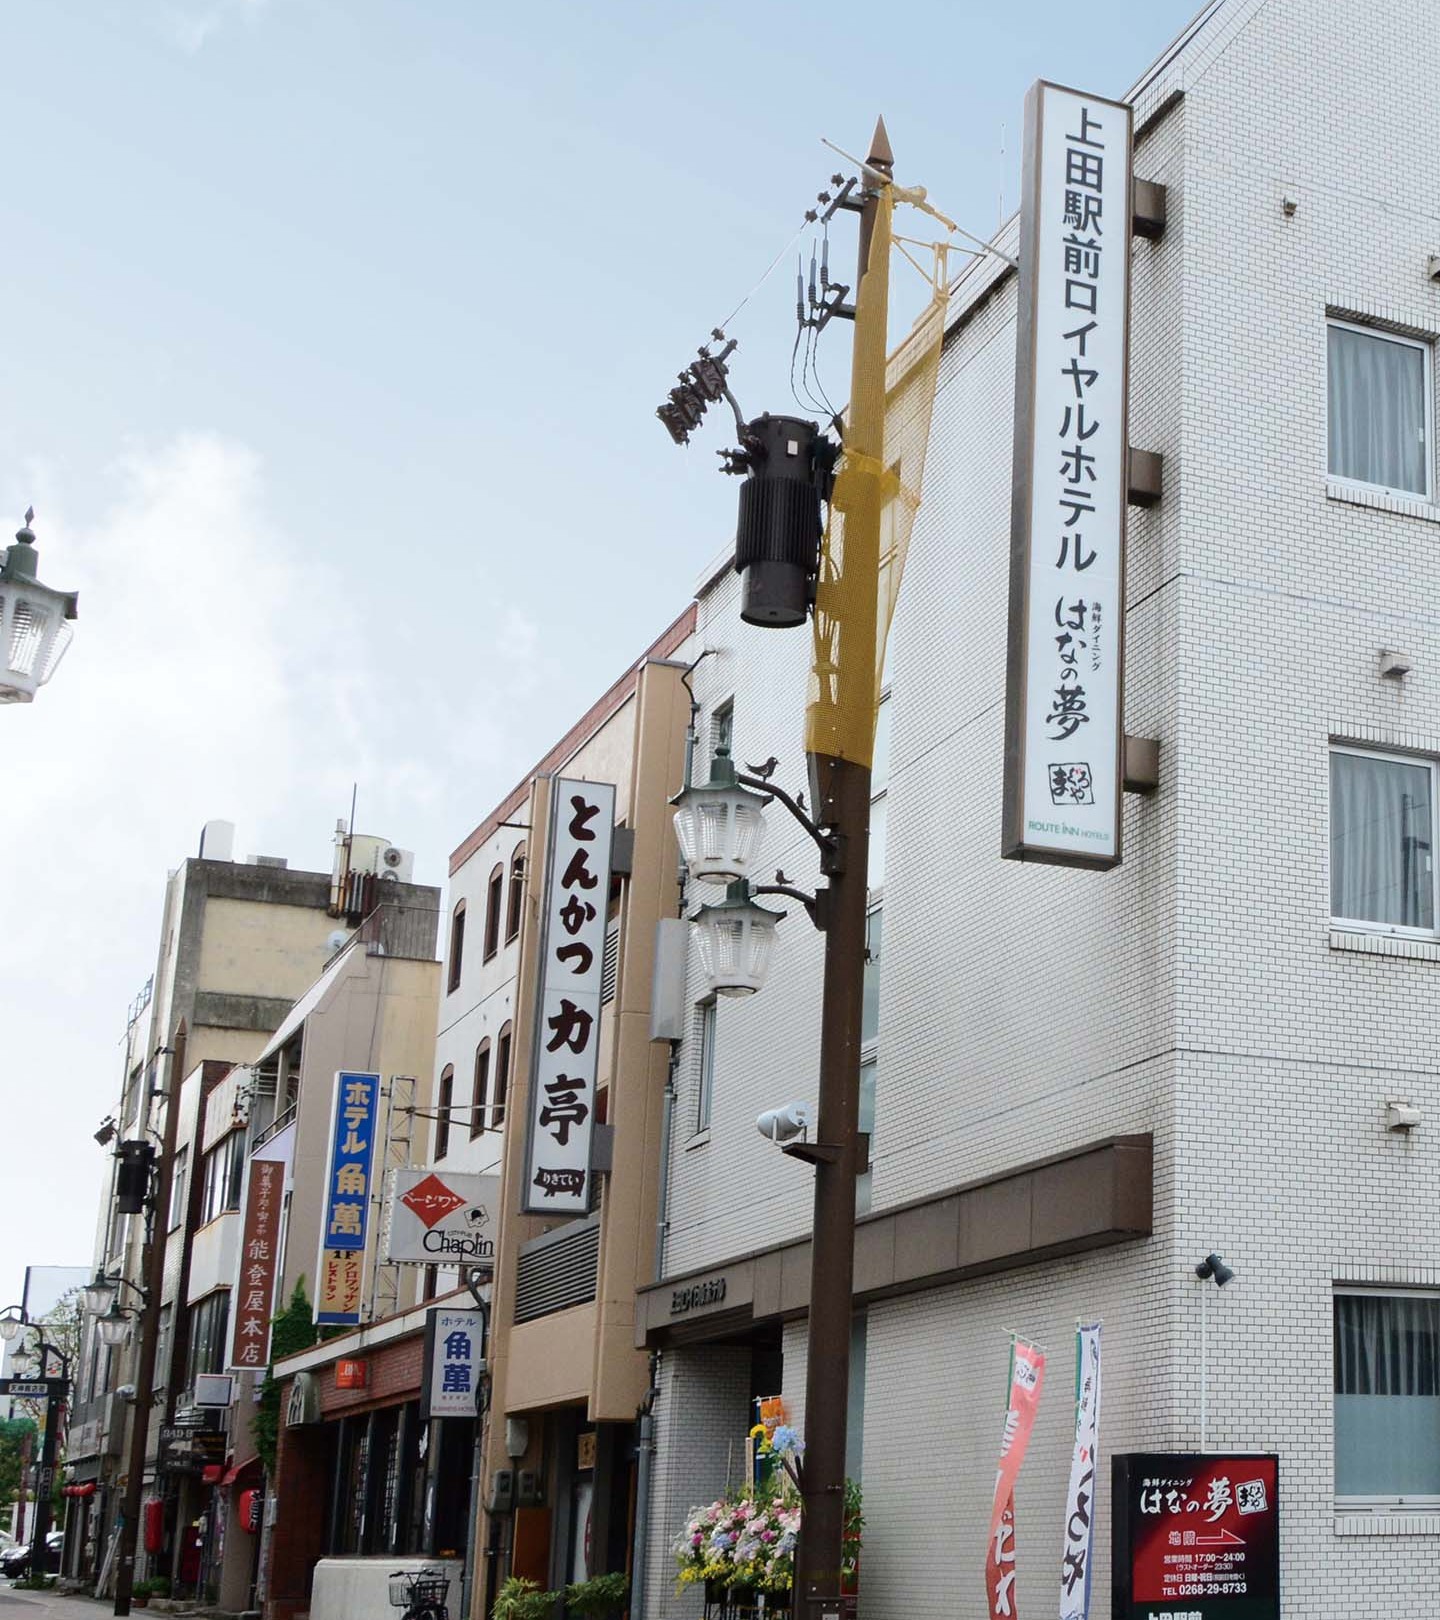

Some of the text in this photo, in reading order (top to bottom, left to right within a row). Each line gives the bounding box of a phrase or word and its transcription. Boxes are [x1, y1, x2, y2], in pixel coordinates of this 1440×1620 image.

[1056, 107, 1105, 572] 上田駅前ロイヤルホテル
[1091, 602, 1103, 671] 海鮮ダイニング
[1045, 596, 1091, 741] はなの夢
[1028, 820, 1061, 834] ROUTE
[1081, 830, 1110, 841] HOTELS
[543, 1172, 579, 1186] りきてい
[333, 1250, 357, 1259] 1F
[423, 1230, 494, 1261] Chaplin
[326, 1261, 339, 1301] レストラン
[240, 1239, 269, 1364] 能登屋本店
[441, 1317, 477, 1327] ホテル
[442, 1331, 472, 1392] 角萬
[1142, 1478, 1193, 1488] 海鮮ダイニング
[1140, 1476, 1233, 1523] はなの夢
[1168, 1531, 1196, 1546] 地階
[1164, 1555, 1192, 1564] 営業時間
[1162, 1583, 1248, 1596] TEL 0268-29-8733
